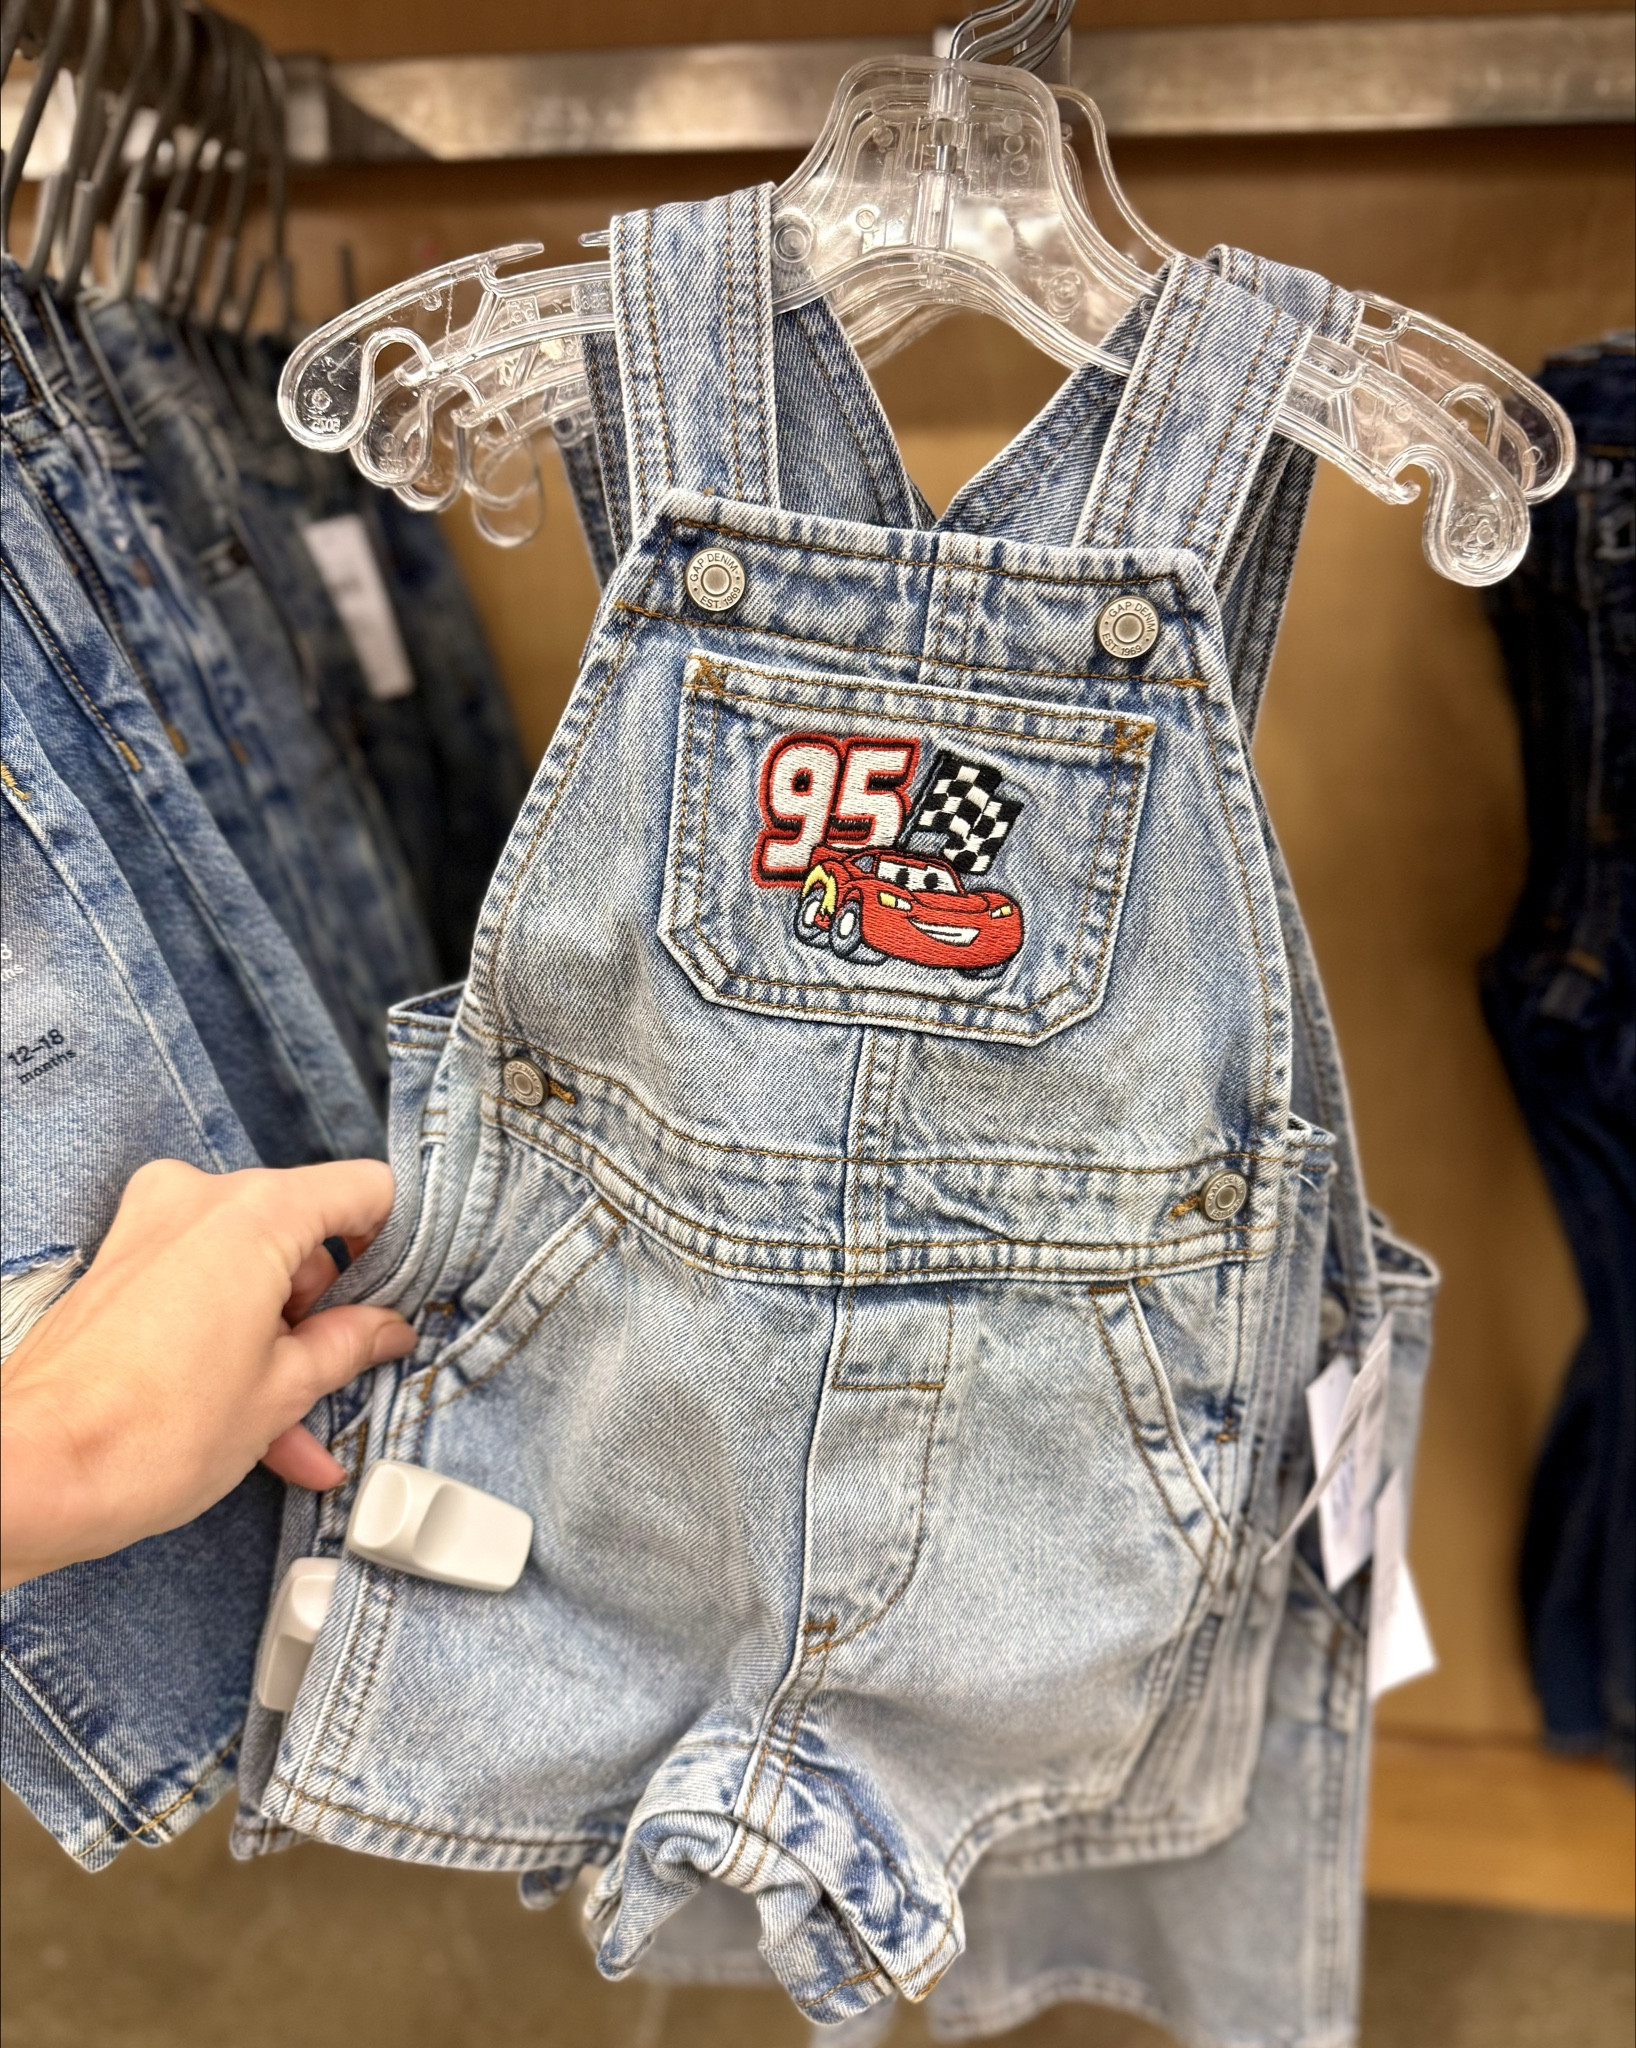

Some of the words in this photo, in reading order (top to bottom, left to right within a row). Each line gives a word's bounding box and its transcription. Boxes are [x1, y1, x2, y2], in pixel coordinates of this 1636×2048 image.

[689, 558, 705, 582] GAP
[707, 552, 739, 572] DENIM
[700, 595, 722, 609] EST.
[723, 587, 741, 606] 1969
[1108, 601, 1132, 618] GAP
[1134, 602, 1156, 633] DENIM
[1101, 633, 1119, 653] EST.
[1120, 645, 1143, 656] 1969
[751, 733, 920, 888] 95
[18, 1049, 77, 1085] months
